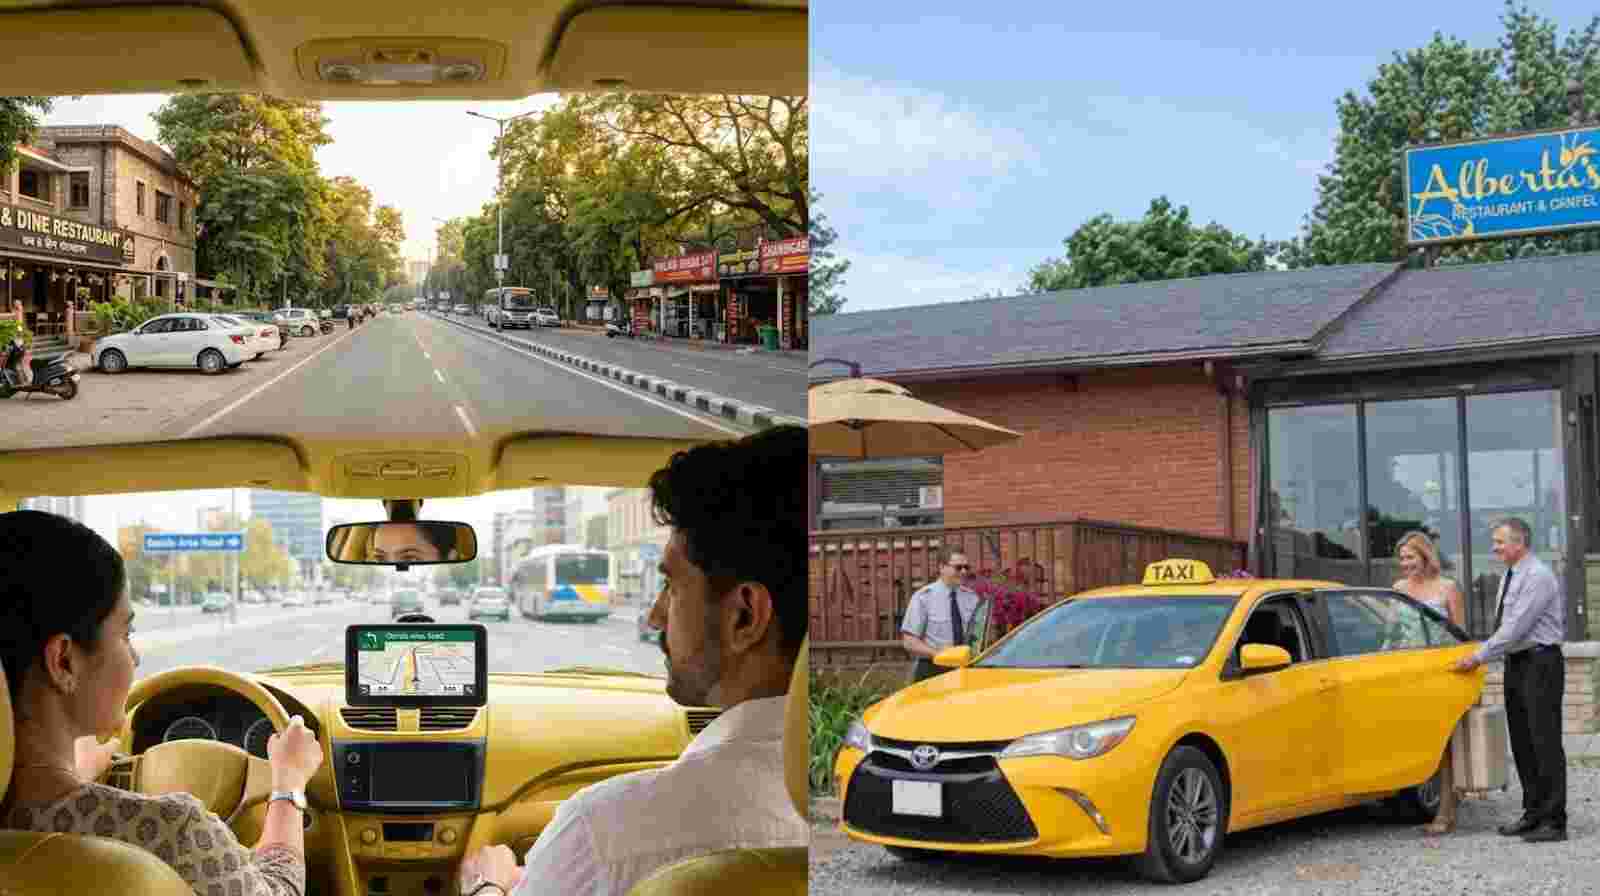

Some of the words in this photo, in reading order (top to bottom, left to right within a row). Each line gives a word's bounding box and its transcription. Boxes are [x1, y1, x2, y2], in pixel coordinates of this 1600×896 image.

[1452, 200, 1536, 219] RESTAURANT
[0, 207, 12, 226] &
[17, 210, 50, 233] DINE
[53, 219, 121, 248] RESTAURANT
[1152, 565, 1193, 579] TAXI
